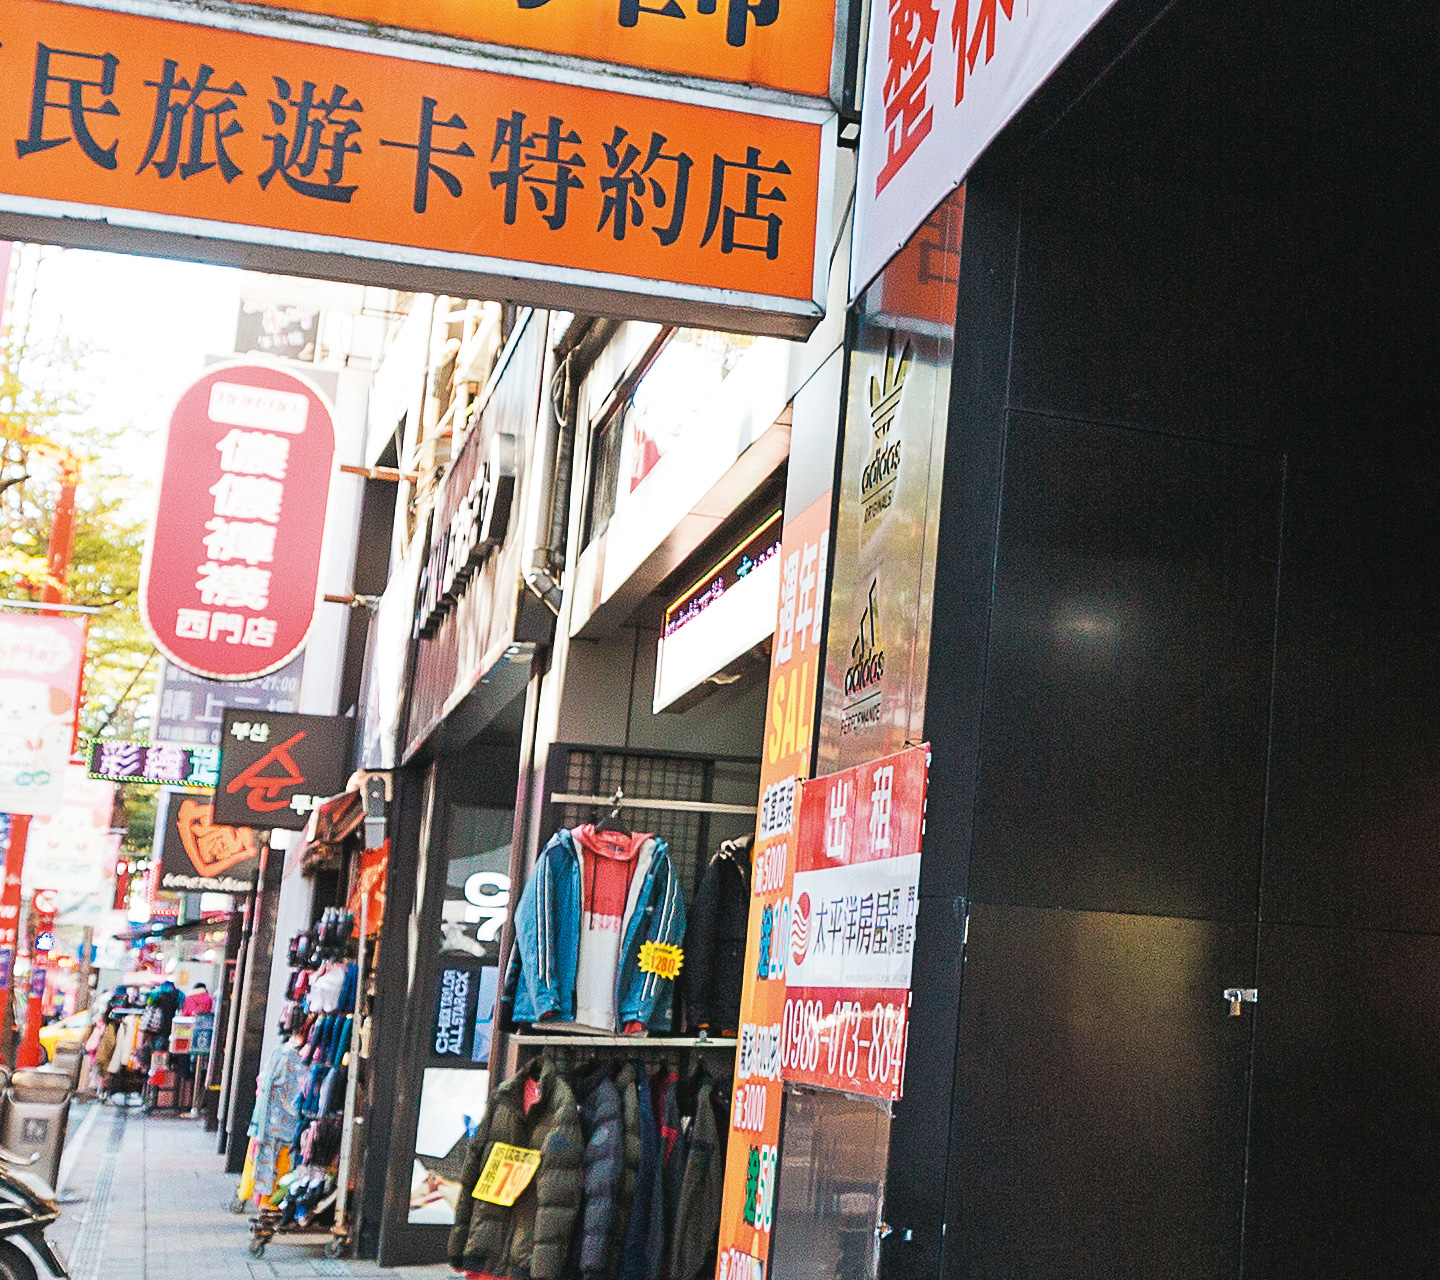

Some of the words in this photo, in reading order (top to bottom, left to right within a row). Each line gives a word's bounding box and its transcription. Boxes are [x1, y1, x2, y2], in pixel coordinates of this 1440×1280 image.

[861, 439, 902, 495] adidas
[174, 607, 278, 648] 西門店
[844, 649, 885, 697] adidas
[768, 654, 820, 765] SAL
[826, 764, 894, 860] 出租
[811, 890, 891, 958] 太平洋房屋
